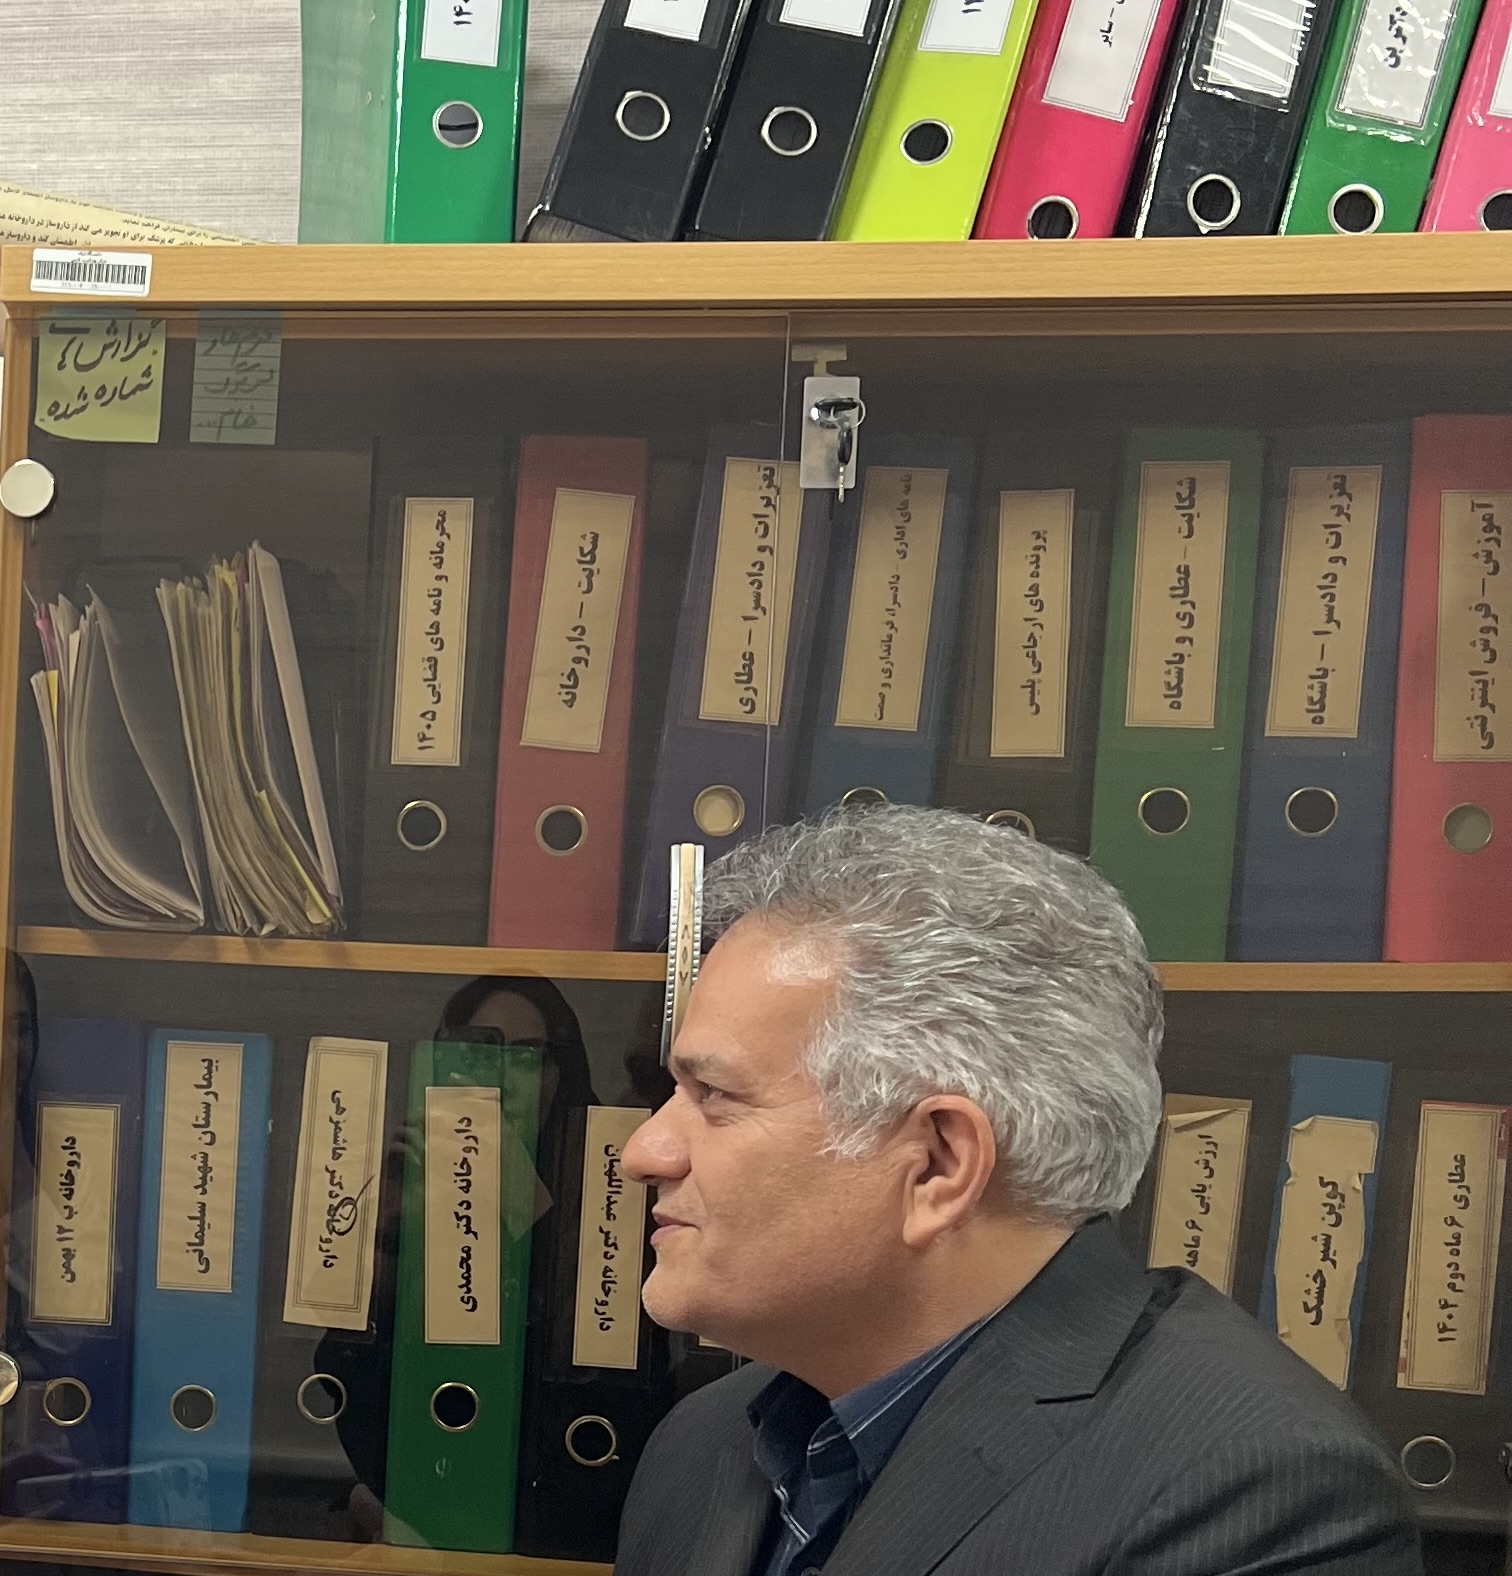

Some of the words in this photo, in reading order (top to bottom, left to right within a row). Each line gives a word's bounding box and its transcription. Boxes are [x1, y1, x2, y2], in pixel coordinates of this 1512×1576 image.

[453, 0, 473, 25] ۱۴
[95, 364, 154, 408] شماره
[752, 464, 780, 539] تعزیرات
[1174, 476, 1201, 540] شکایت
[1320, 473, 1353, 550] تعزیرات
[429, 509, 451, 570] محرمانه
[576, 531, 601, 595] شکایت
[756, 545, 774, 556] و
[1024, 528, 1048, 579] پرونده
[1328, 555, 1348, 567] و
[1470, 500, 1502, 577] آموزش
[427, 587, 443, 615] نامه
[434, 574, 448, 583] و
[741, 560, 767, 621] دادسرا
[1023, 582, 1045, 613] های
[1169, 563, 1196, 630] عطاری
[1312, 572, 1341, 636] دادسرا
[424, 620, 445, 651] های
[1175, 635, 1194, 647] و
[1468, 602, 1499, 665] فروش
[423, 656, 442, 705] قضایی
[557, 624, 591, 709] داروخانه
[734, 650, 759, 715] عطاری
[1162, 651, 1192, 711] باشگاه
[1304, 666, 1337, 726] باشگاه
[1466, 670, 1497, 751] اینترنتی
[417, 709, 437, 751] ۱۴۰۵
[192, 1057, 219, 1146] بیمارستان
[58, 1135, 81, 1201] داروخانه
[190, 1151, 214, 1196] شهید
[453, 1116, 480, 1195] داروخانه
[600, 1143, 623, 1222] عبداللهیان
[1447, 1153, 1471, 1210] عطاری
[453, 1200, 479, 1241] دکتر
[1318, 1175, 1346, 1228] کوپن
[61, 1247, 77, 1283] بهمن
[185, 1201, 211, 1274] سلیمانی
[598, 1225, 620, 1262] دکتر
[1183, 1235, 1202, 1268] ماهه
[1311, 1233, 1338, 1270] شیر
[1443, 1231, 1462, 1257] ماه
[457, 1245, 478, 1313] محمدی
[593, 1264, 618, 1333] داروخانه
[1302, 1268, 1327, 1327] خشک
[1446, 1262, 1466, 1293] دوم
[1436, 1298, 1460, 1343] ۱۴۰۴
